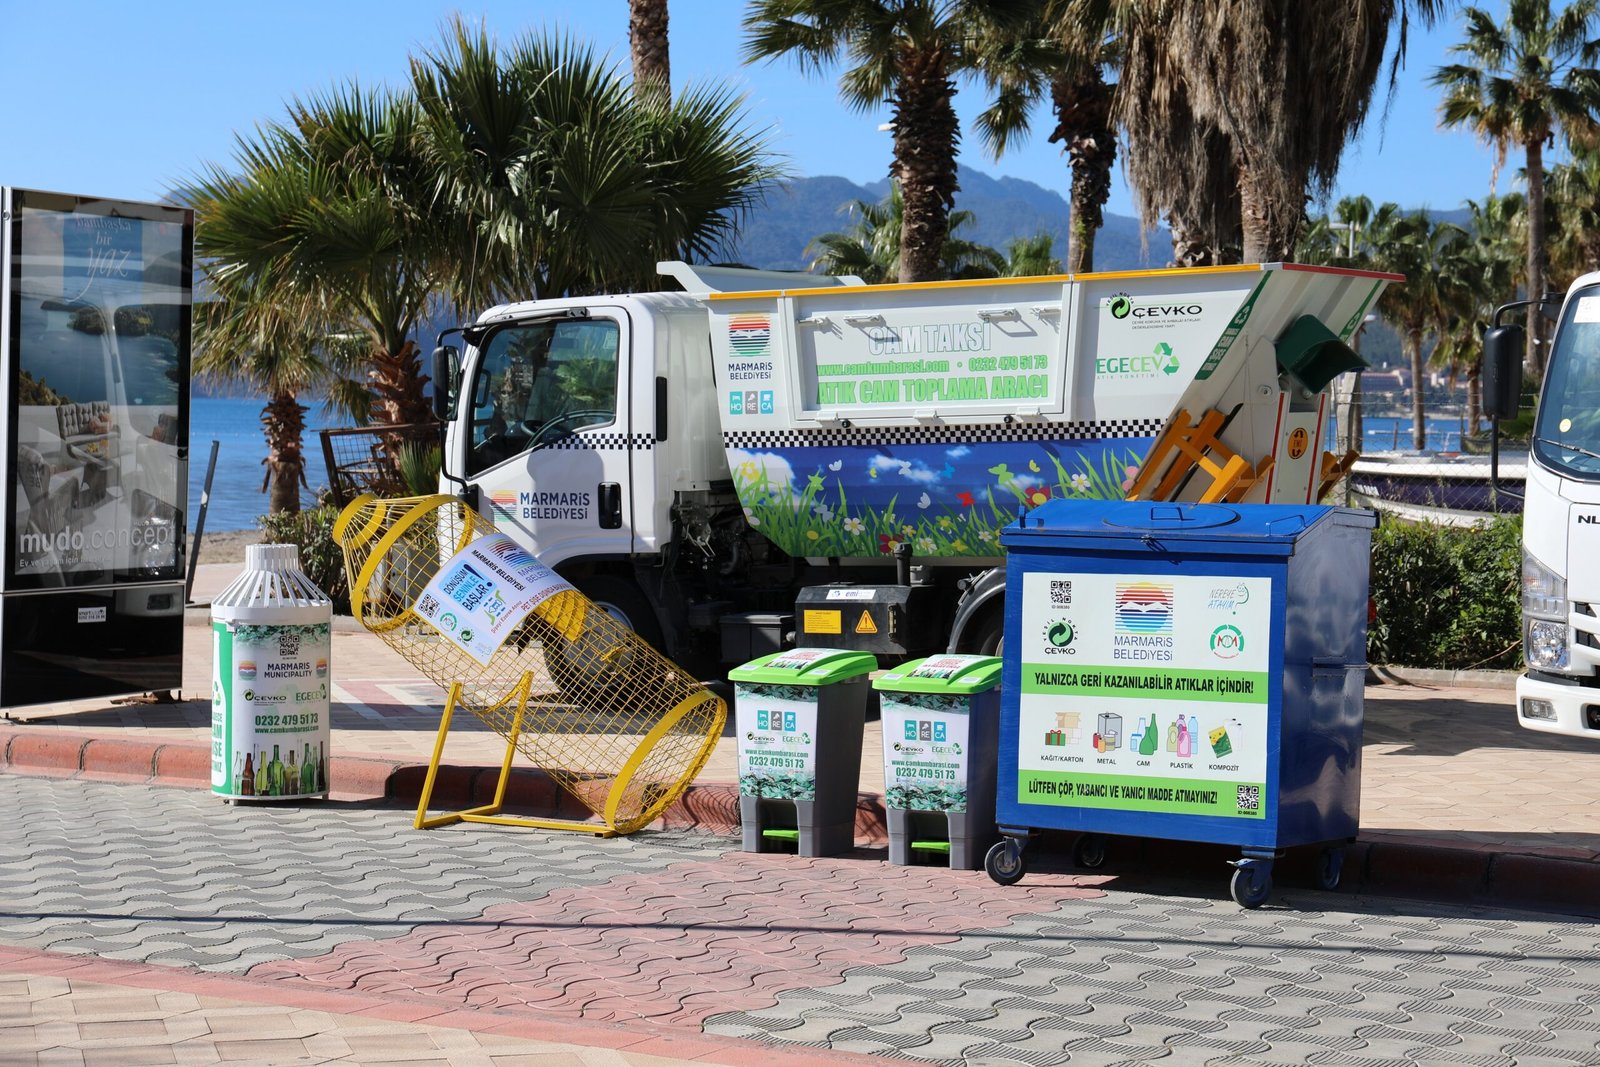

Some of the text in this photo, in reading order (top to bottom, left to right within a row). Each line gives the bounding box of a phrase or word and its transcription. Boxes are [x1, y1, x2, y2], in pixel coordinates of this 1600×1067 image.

[1132, 305, 1202, 319] ÇEVKO
[869, 317, 992, 356] CAM TAKSİ
[968, 356, 997, 372] 0232
[998, 355, 1018, 371] 479
[1020, 355, 1032, 370] 51
[1034, 354, 1048, 369] 73
[1095, 355, 1164, 374] EGECEV
[816, 374, 1049, 404] ATIK CAM TOPLAMA ARACI
[730, 402, 772, 412] HO RE CA
[521, 601, 531, 611] PET
[1044, 647, 1076, 655] ÇEVKO
[267, 662, 310, 671] MARMARIS
[264, 670, 313, 679] MUNICIPALITY
[1035, 671, 1254, 695] YALNIZCA GERİ KAZANILABİLİR ATIKLAR İÇİNDİR!
[255, 712, 319, 726] 0232 479 51 73
[772, 720, 781, 728] RE
[785, 721, 795, 729] CA
[905, 730, 945, 739] HO RE CA
[749, 756, 804, 769] 0232 479 51 73
[1040, 755, 1084, 763] KAĞIT/KARTON
[1169, 761, 1194, 769] PLASTİK
[1208, 763, 1240, 772] KOMPOZİT
[896, 767, 955, 780] 0232 479 51 73
[1029, 778, 1218, 805] LÜTFEN ÇÖP, YABANCI VE YANICI MADDE ATMAYINIZ!
